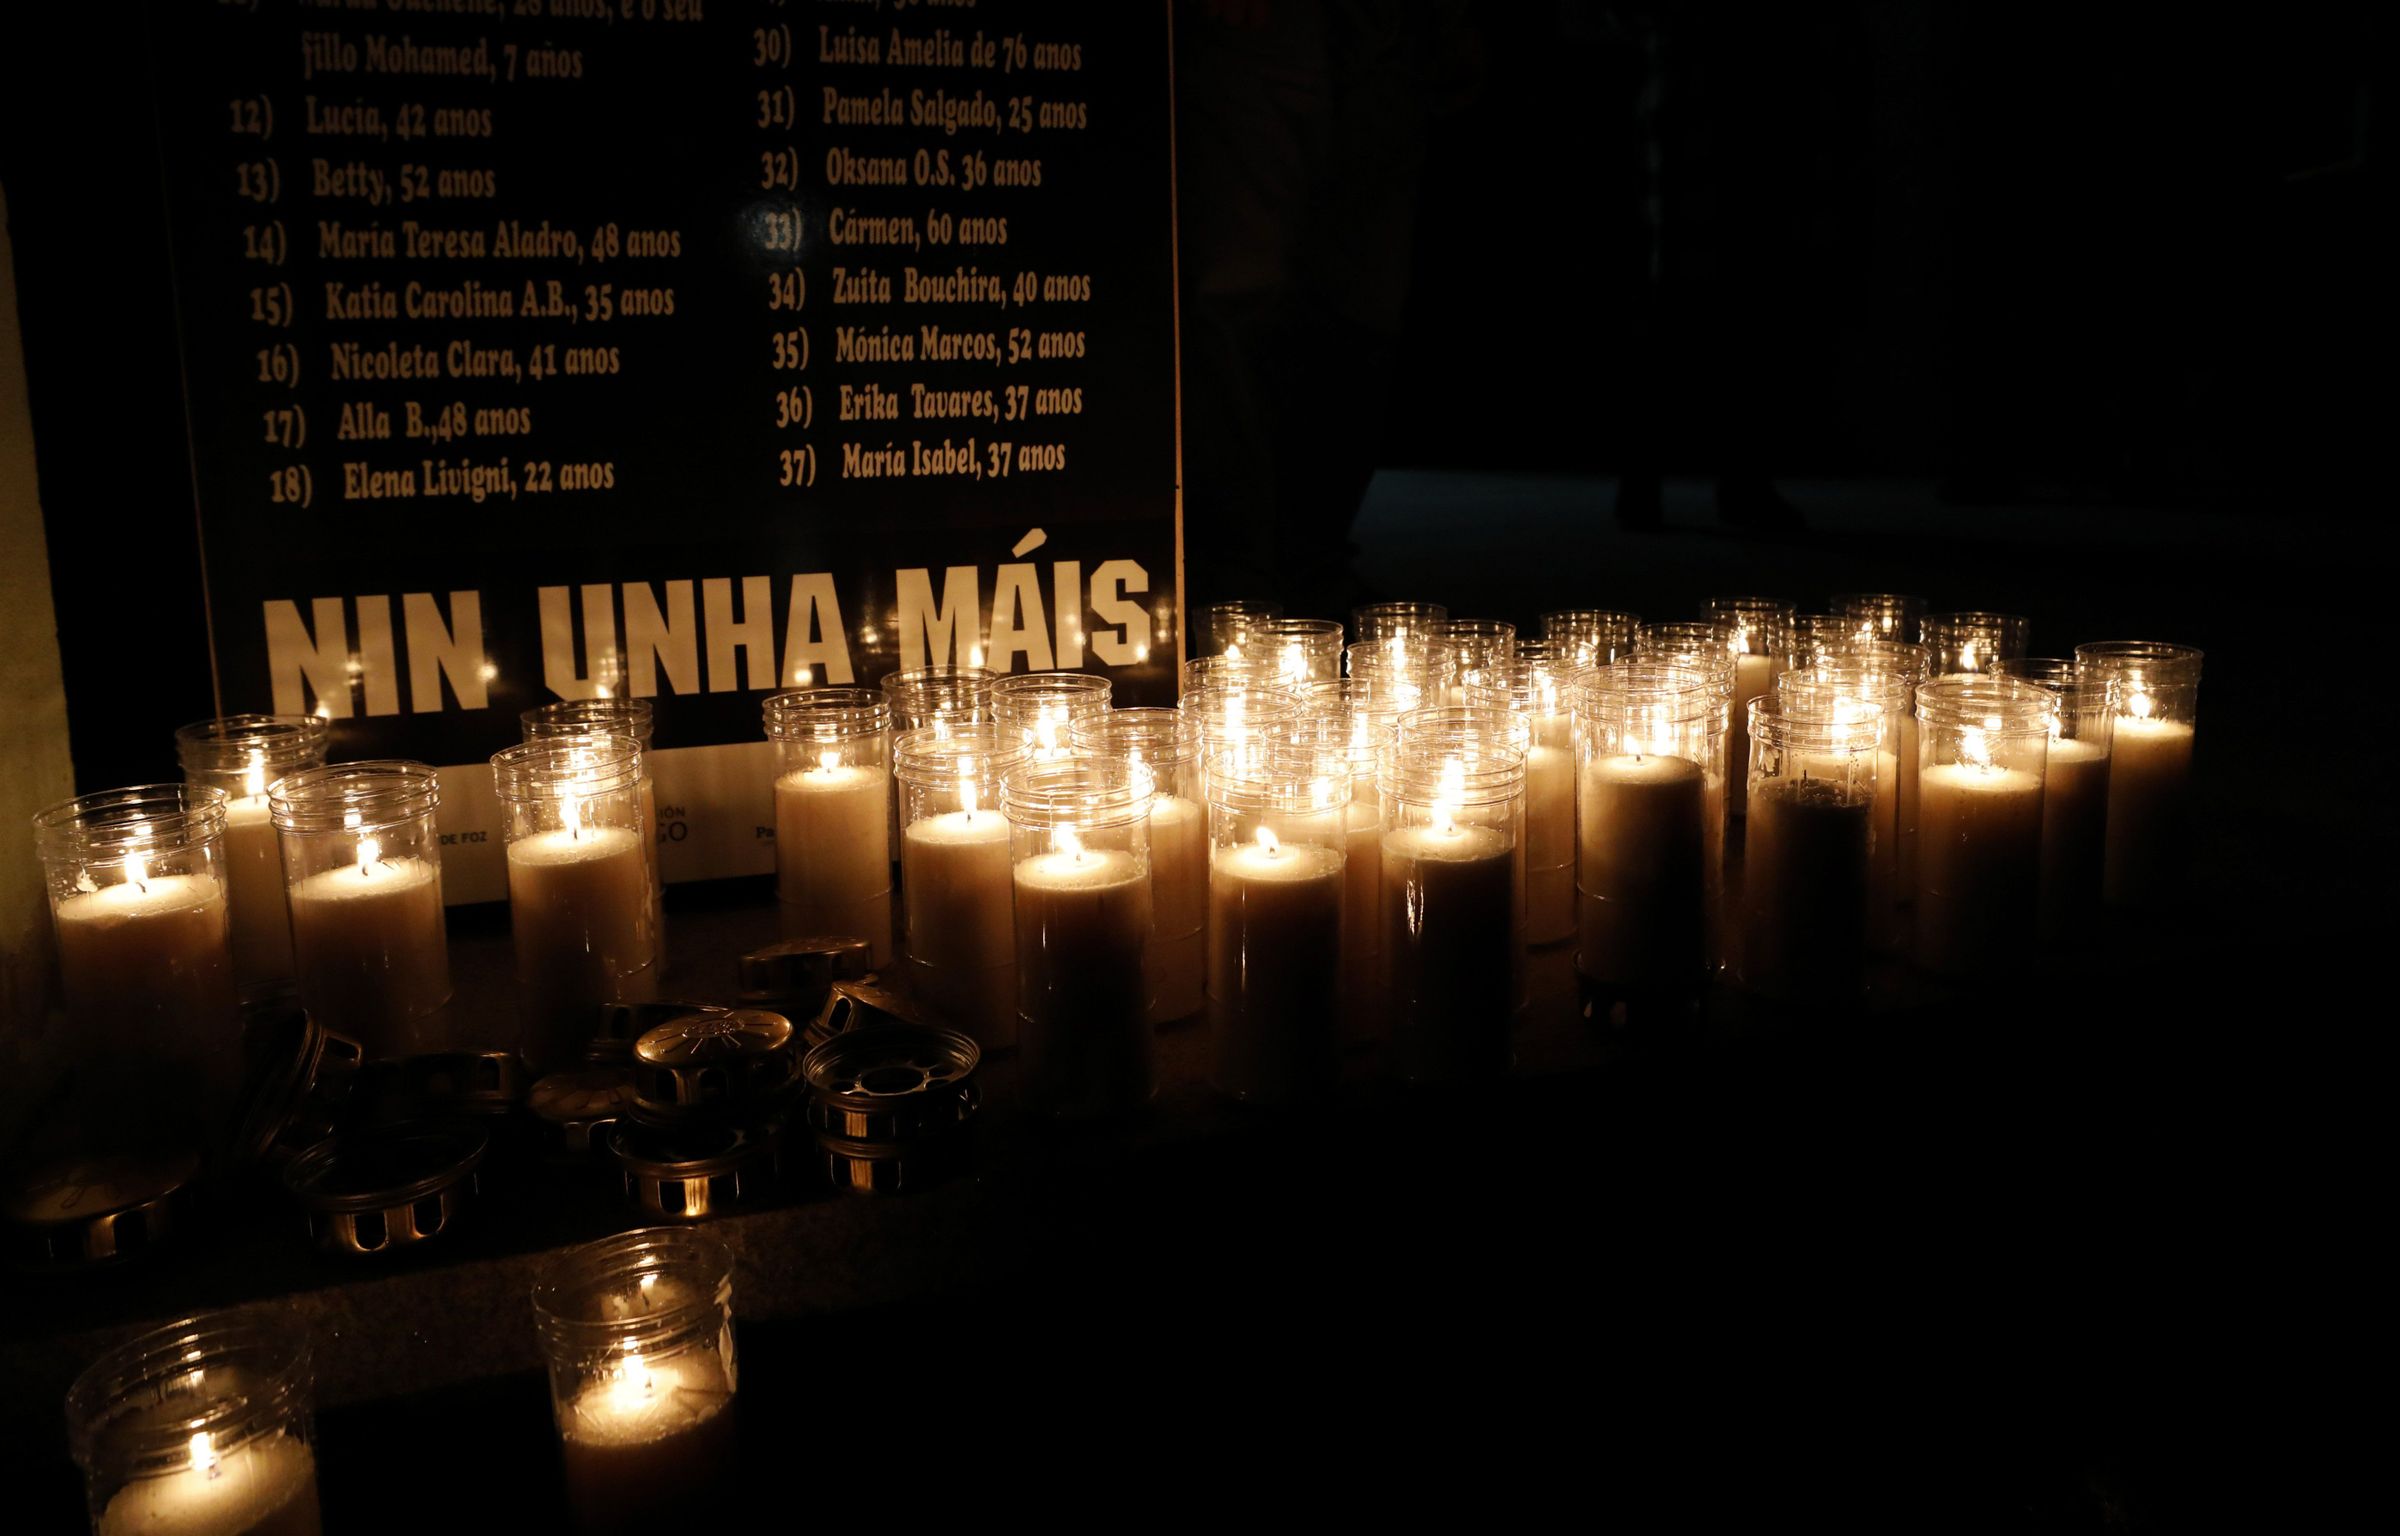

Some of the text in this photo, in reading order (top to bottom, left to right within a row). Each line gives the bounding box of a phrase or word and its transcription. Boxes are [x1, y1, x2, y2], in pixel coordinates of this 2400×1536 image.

[303, 32, 583, 84] fillo Mohamed, 7 años
[753, 23, 1082, 74] 30) Luisa Amelia de 76 anos
[230, 95, 273, 141] 12)
[396, 103, 426, 140] 42
[434, 108, 493, 138] anos
[757, 84, 1087, 136] 31) Pamela Salgado, 25 anos
[237, 158, 496, 206] 13) Betty, 52 anos
[761, 146, 1042, 192] 32) Oksana O.S. 36 anos
[243, 219, 681, 266] 14) María Teresa Aladro, 48 anos
[762, 207, 1008, 253] 33) Cármen, 60 anos
[250, 279, 675, 328] 15) Katia Carolina A.B., 35 anos
[768, 266, 1091, 311] 34) Zuita Bouchira, 40 anos
[257, 339, 620, 389] 16) Nicoleta Clara, 41 anos
[772, 325, 1086, 371] 35) Mónica Marcos, 52 anos
[263, 404, 306, 449] 17)
[337, 401, 391, 441] Alla
[474, 407, 531, 436] anos
[775, 383, 1083, 429] 36) Erika Tavares, 37 anos
[270, 456, 615, 509] 18) Elena Livigni, 22 anos
[779, 437, 1066, 488] 37) María Isabel, 37 anos
[262, 527, 1150, 718] NIN UNHA MÁIS
[440, 831, 488, 846] DE FOZ
